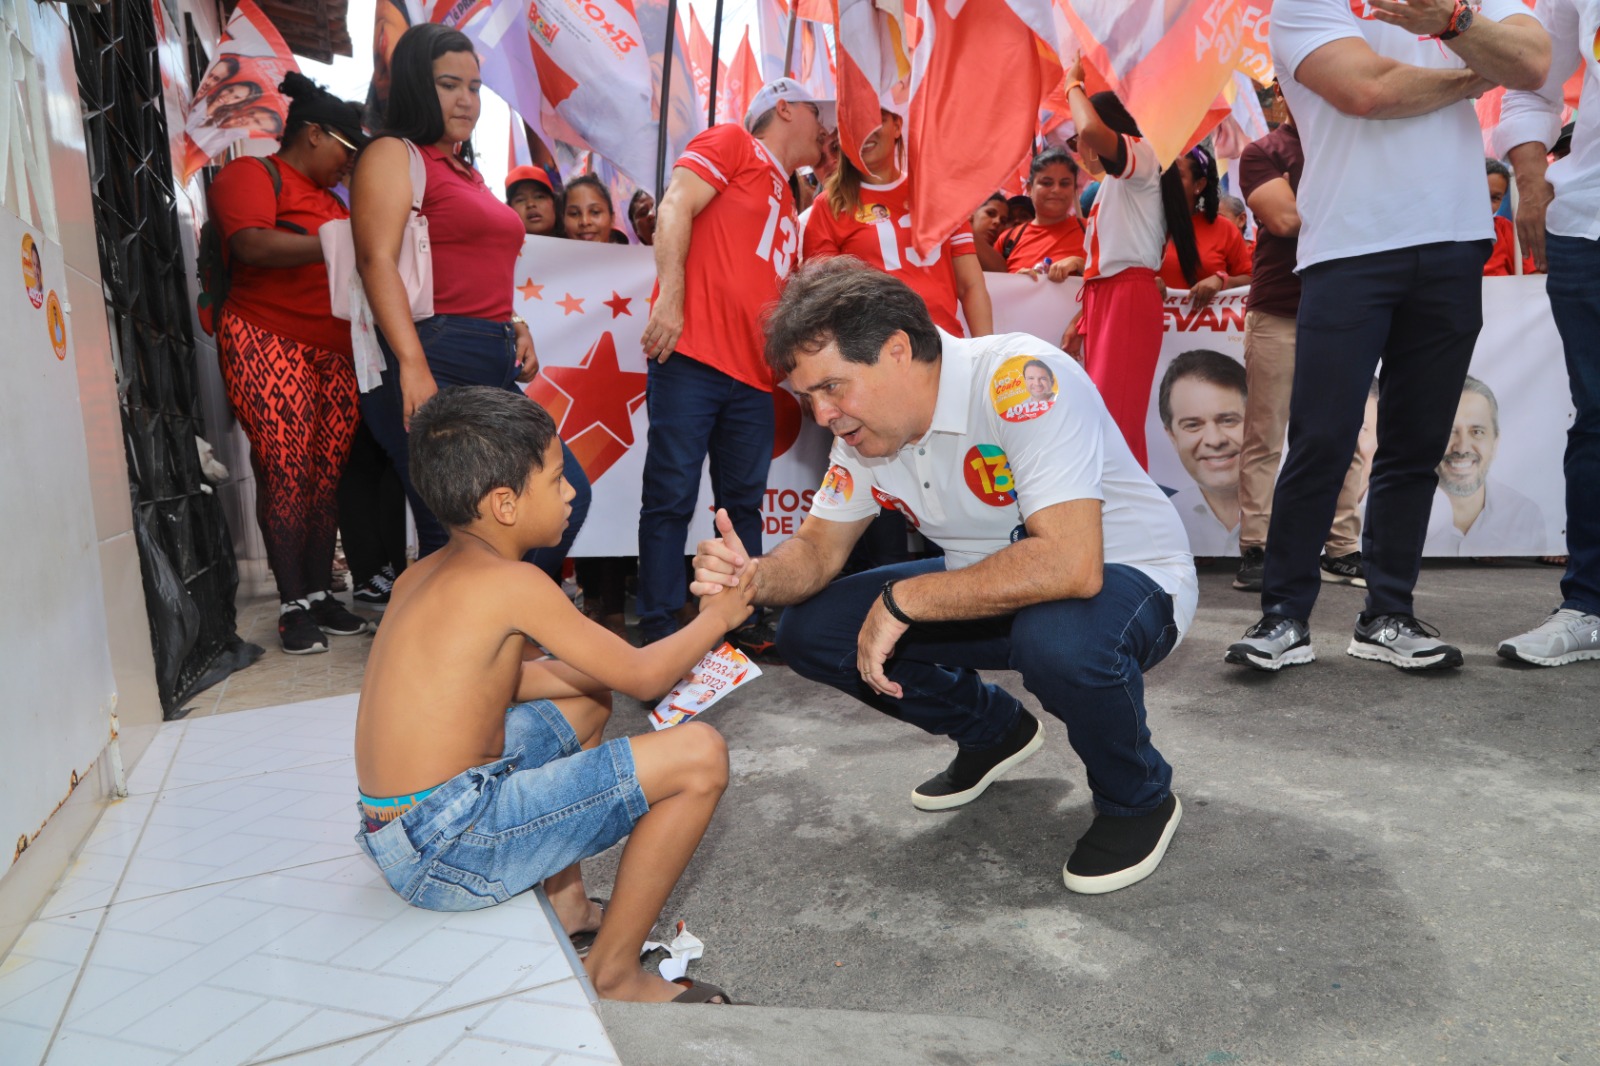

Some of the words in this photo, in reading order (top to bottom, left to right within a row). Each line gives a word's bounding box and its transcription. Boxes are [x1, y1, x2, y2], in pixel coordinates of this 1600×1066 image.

[528, 1, 559, 43] Brasil
[755, 195, 797, 280] 13
[1163, 307, 1246, 332] EVAN
[242, 372, 277, 436] POWER
[268, 381, 303, 443] POWER
[1006, 400, 1049, 419] 40123
[970, 454, 1015, 494] 13
[1333, 562, 1357, 575] FILA
